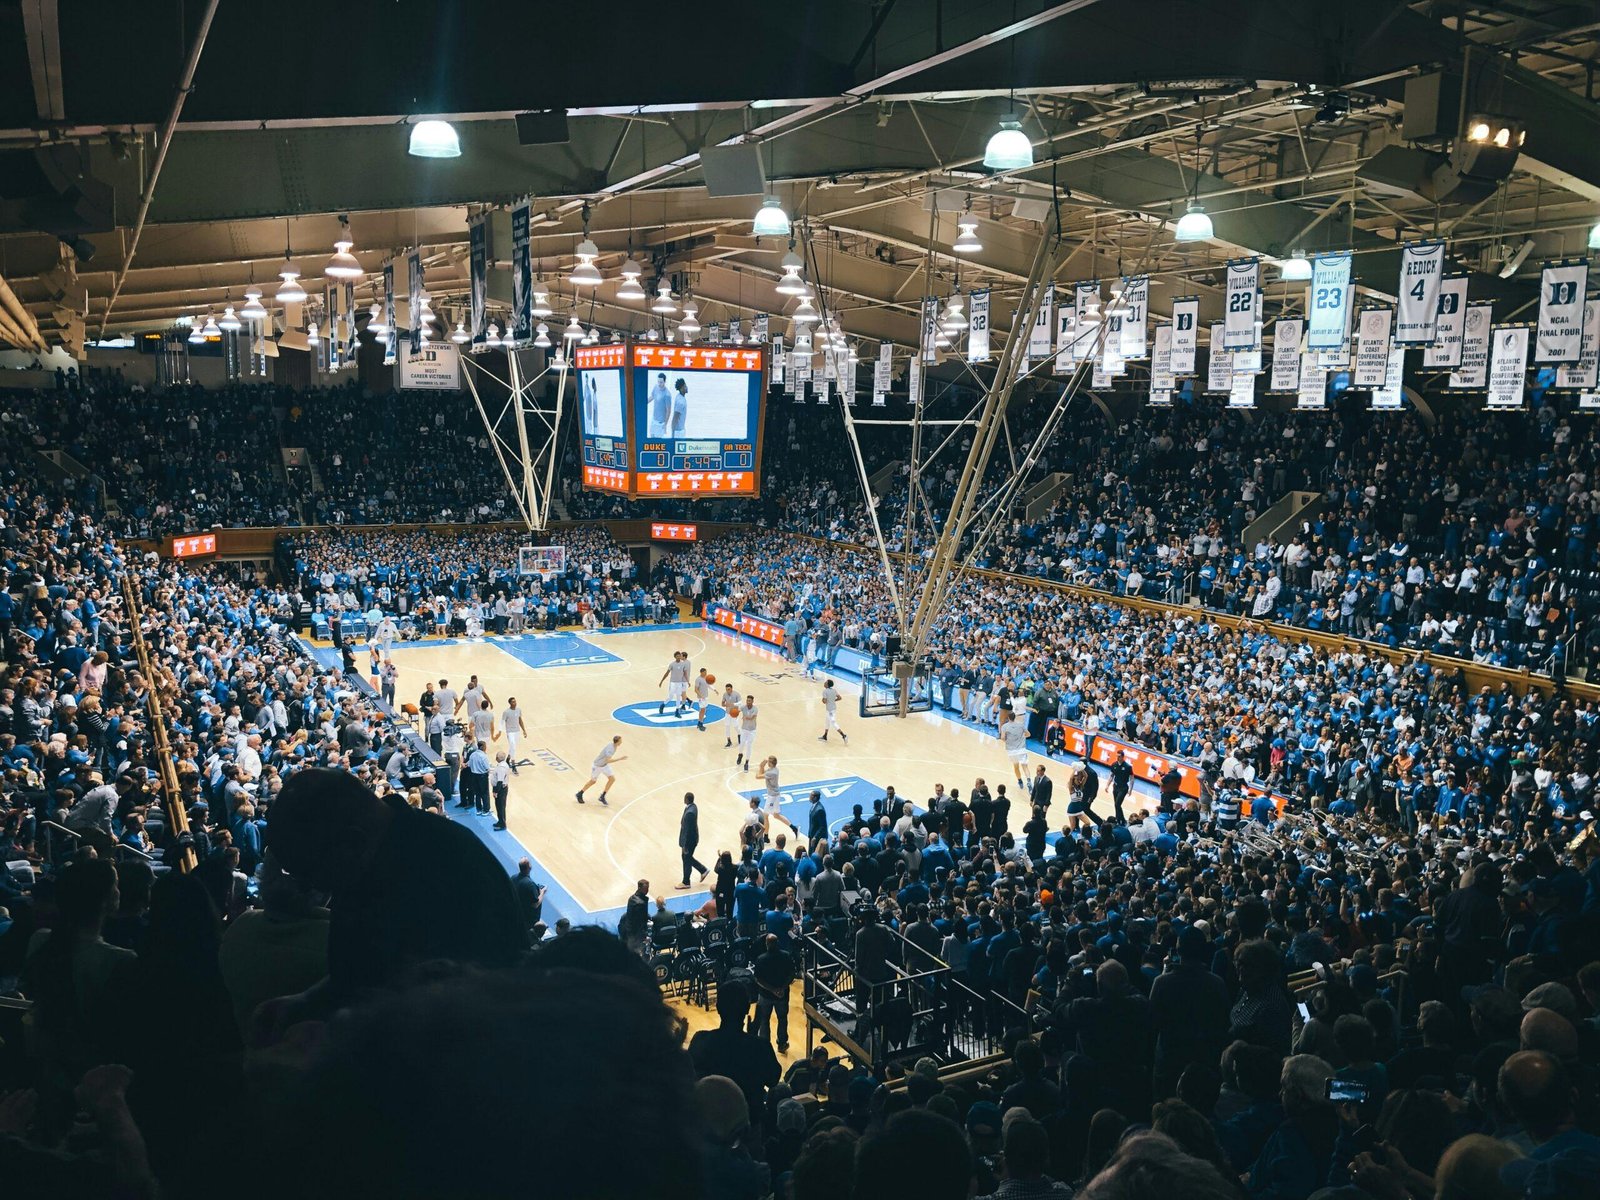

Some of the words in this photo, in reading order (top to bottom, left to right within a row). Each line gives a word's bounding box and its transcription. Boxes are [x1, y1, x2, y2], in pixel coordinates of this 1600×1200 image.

[1407, 259, 1437, 276] REDICK
[1229, 276, 1255, 290] WILLIAMS
[1410, 279, 1425, 301] 4
[1230, 292, 1252, 312] 22
[1317, 288, 1342, 309] 23
[1127, 305, 1141, 323] 31
[973, 315, 986, 330] 32
[1539, 329, 1558, 337] FINAL
[1560, 328, 1580, 336] FOUR
[658, 453, 664, 466] 0
[684, 456, 710, 469] 6:49
[740, 454, 747, 466] 0
[537, 655, 609, 667] ACC
